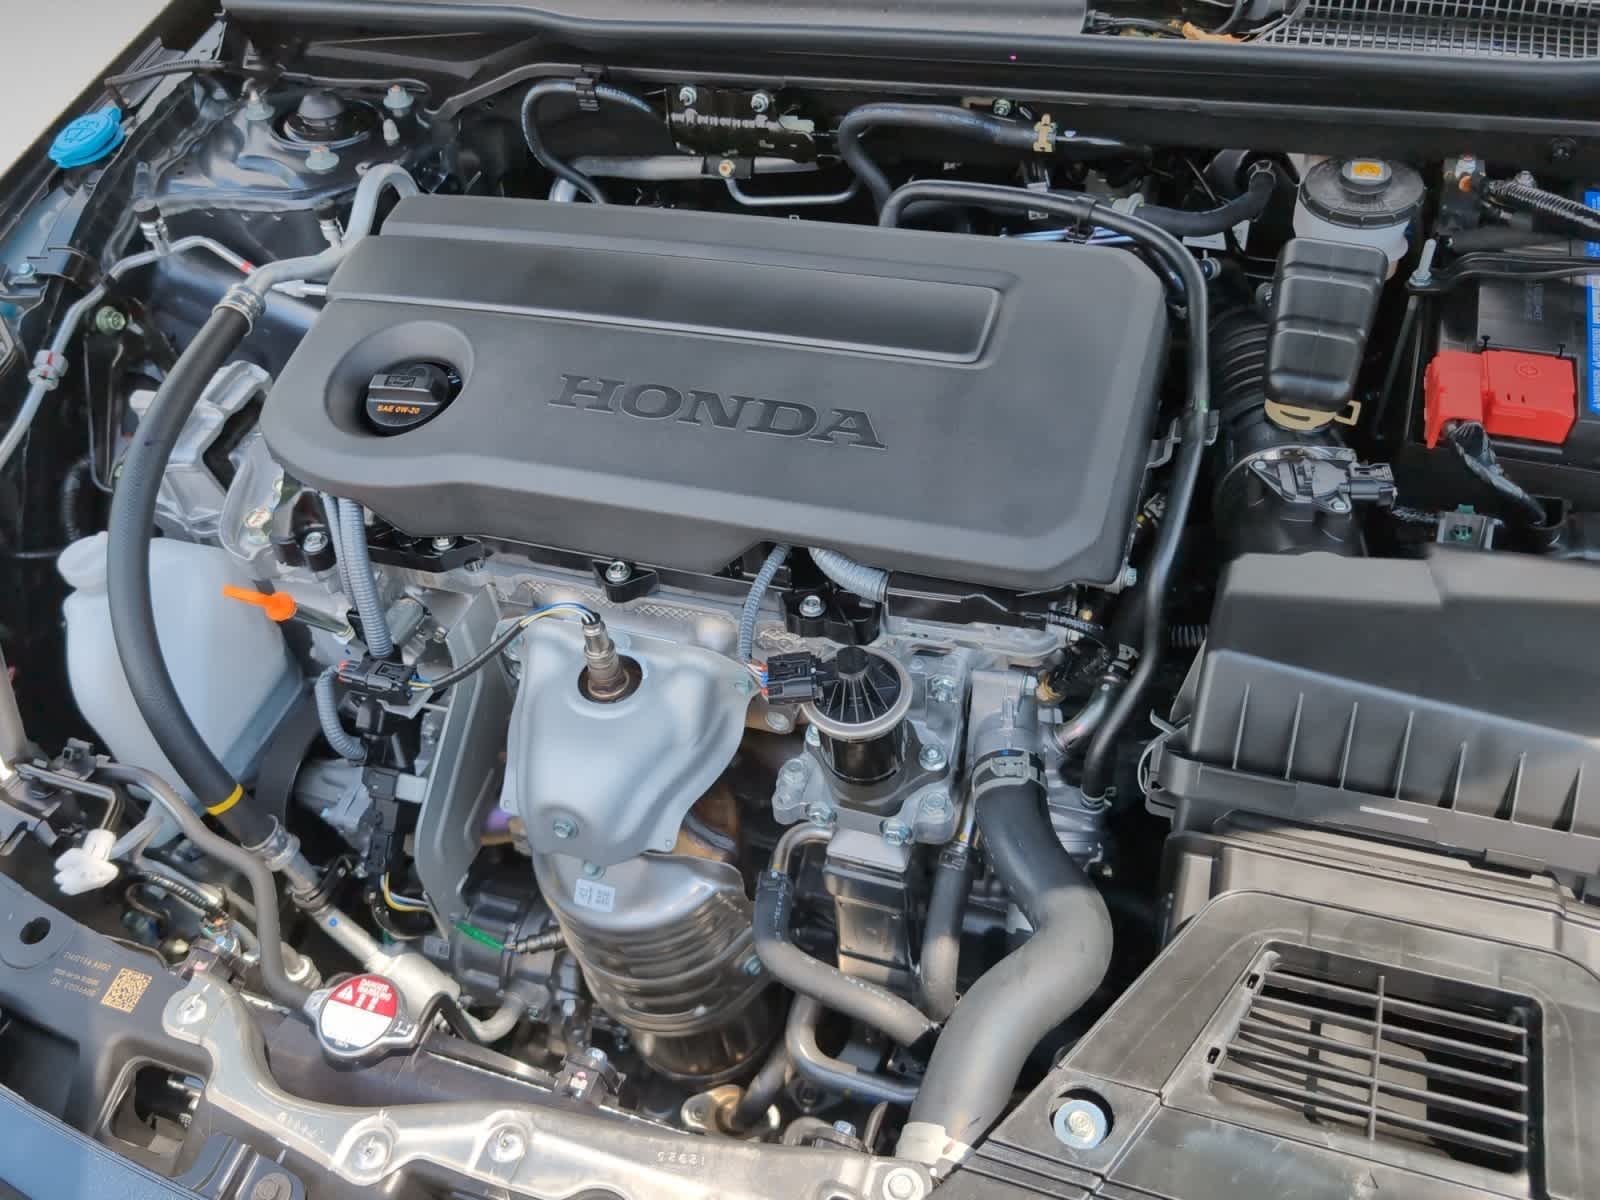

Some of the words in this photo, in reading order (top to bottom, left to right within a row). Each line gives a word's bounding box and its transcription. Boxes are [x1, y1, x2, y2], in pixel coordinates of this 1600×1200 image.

[377, 404, 395, 413] SAE
[394, 405, 421, 415] 0W-20
[548, 374, 887, 450] HONDA
